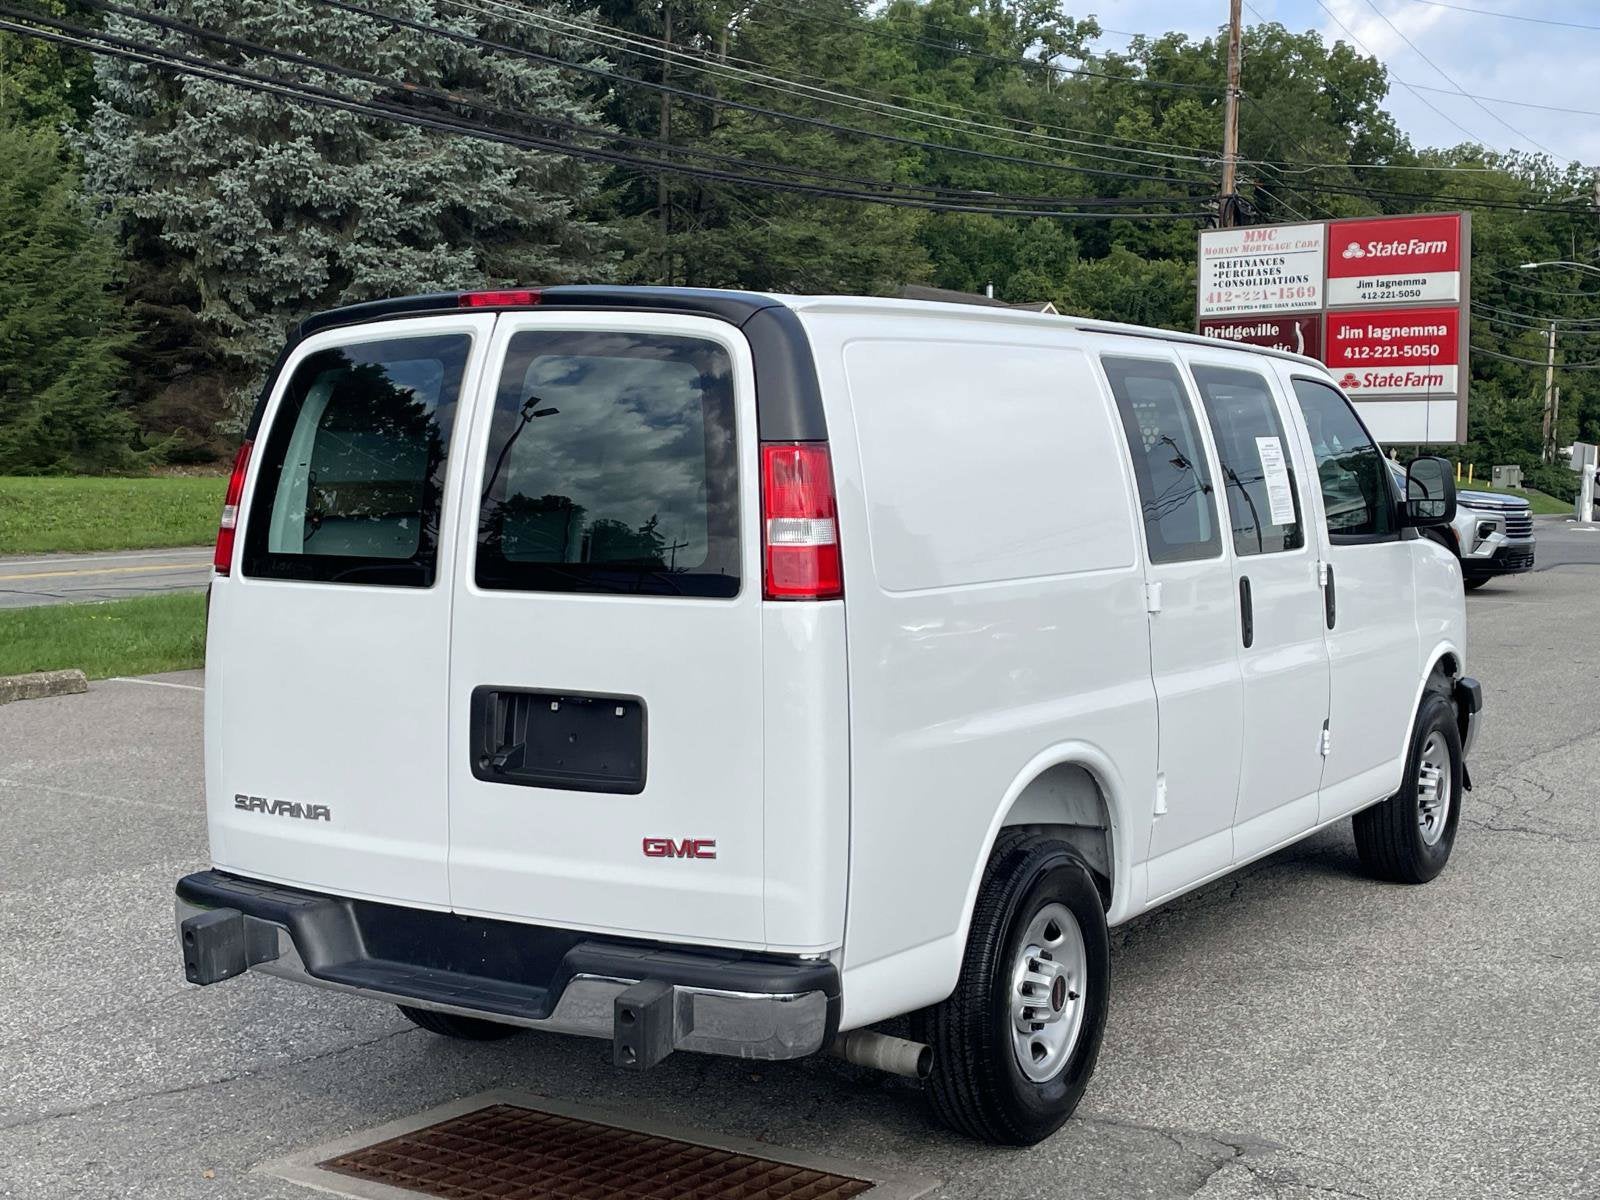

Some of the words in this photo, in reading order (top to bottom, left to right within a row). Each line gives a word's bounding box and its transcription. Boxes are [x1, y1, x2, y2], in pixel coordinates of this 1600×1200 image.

[1243, 229, 1278, 243] MMC
[1241, 242, 1292, 253] MORTGAGE
[1218, 257, 1285, 269] REFINANCES
[1218, 267, 1282, 279] PURCHASES
[1218, 275, 1309, 289] CONSOLIDATIONS
[1356, 280, 1373, 289] Jim
[1376, 278, 1427, 289] Iagnemma
[1206, 286, 1316, 304] 412-221-1569
[1361, 290, 1421, 300] 412-221-5050
[1204, 323, 1280, 340] Bridgeville
[1336, 326, 1363, 340] Jim
[1368, 325, 1448, 341] Iagnemma
[1344, 344, 1440, 359] 412-221-5050
[234, 794, 331, 821] SAVANA
[643, 837, 717, 859] GMC
